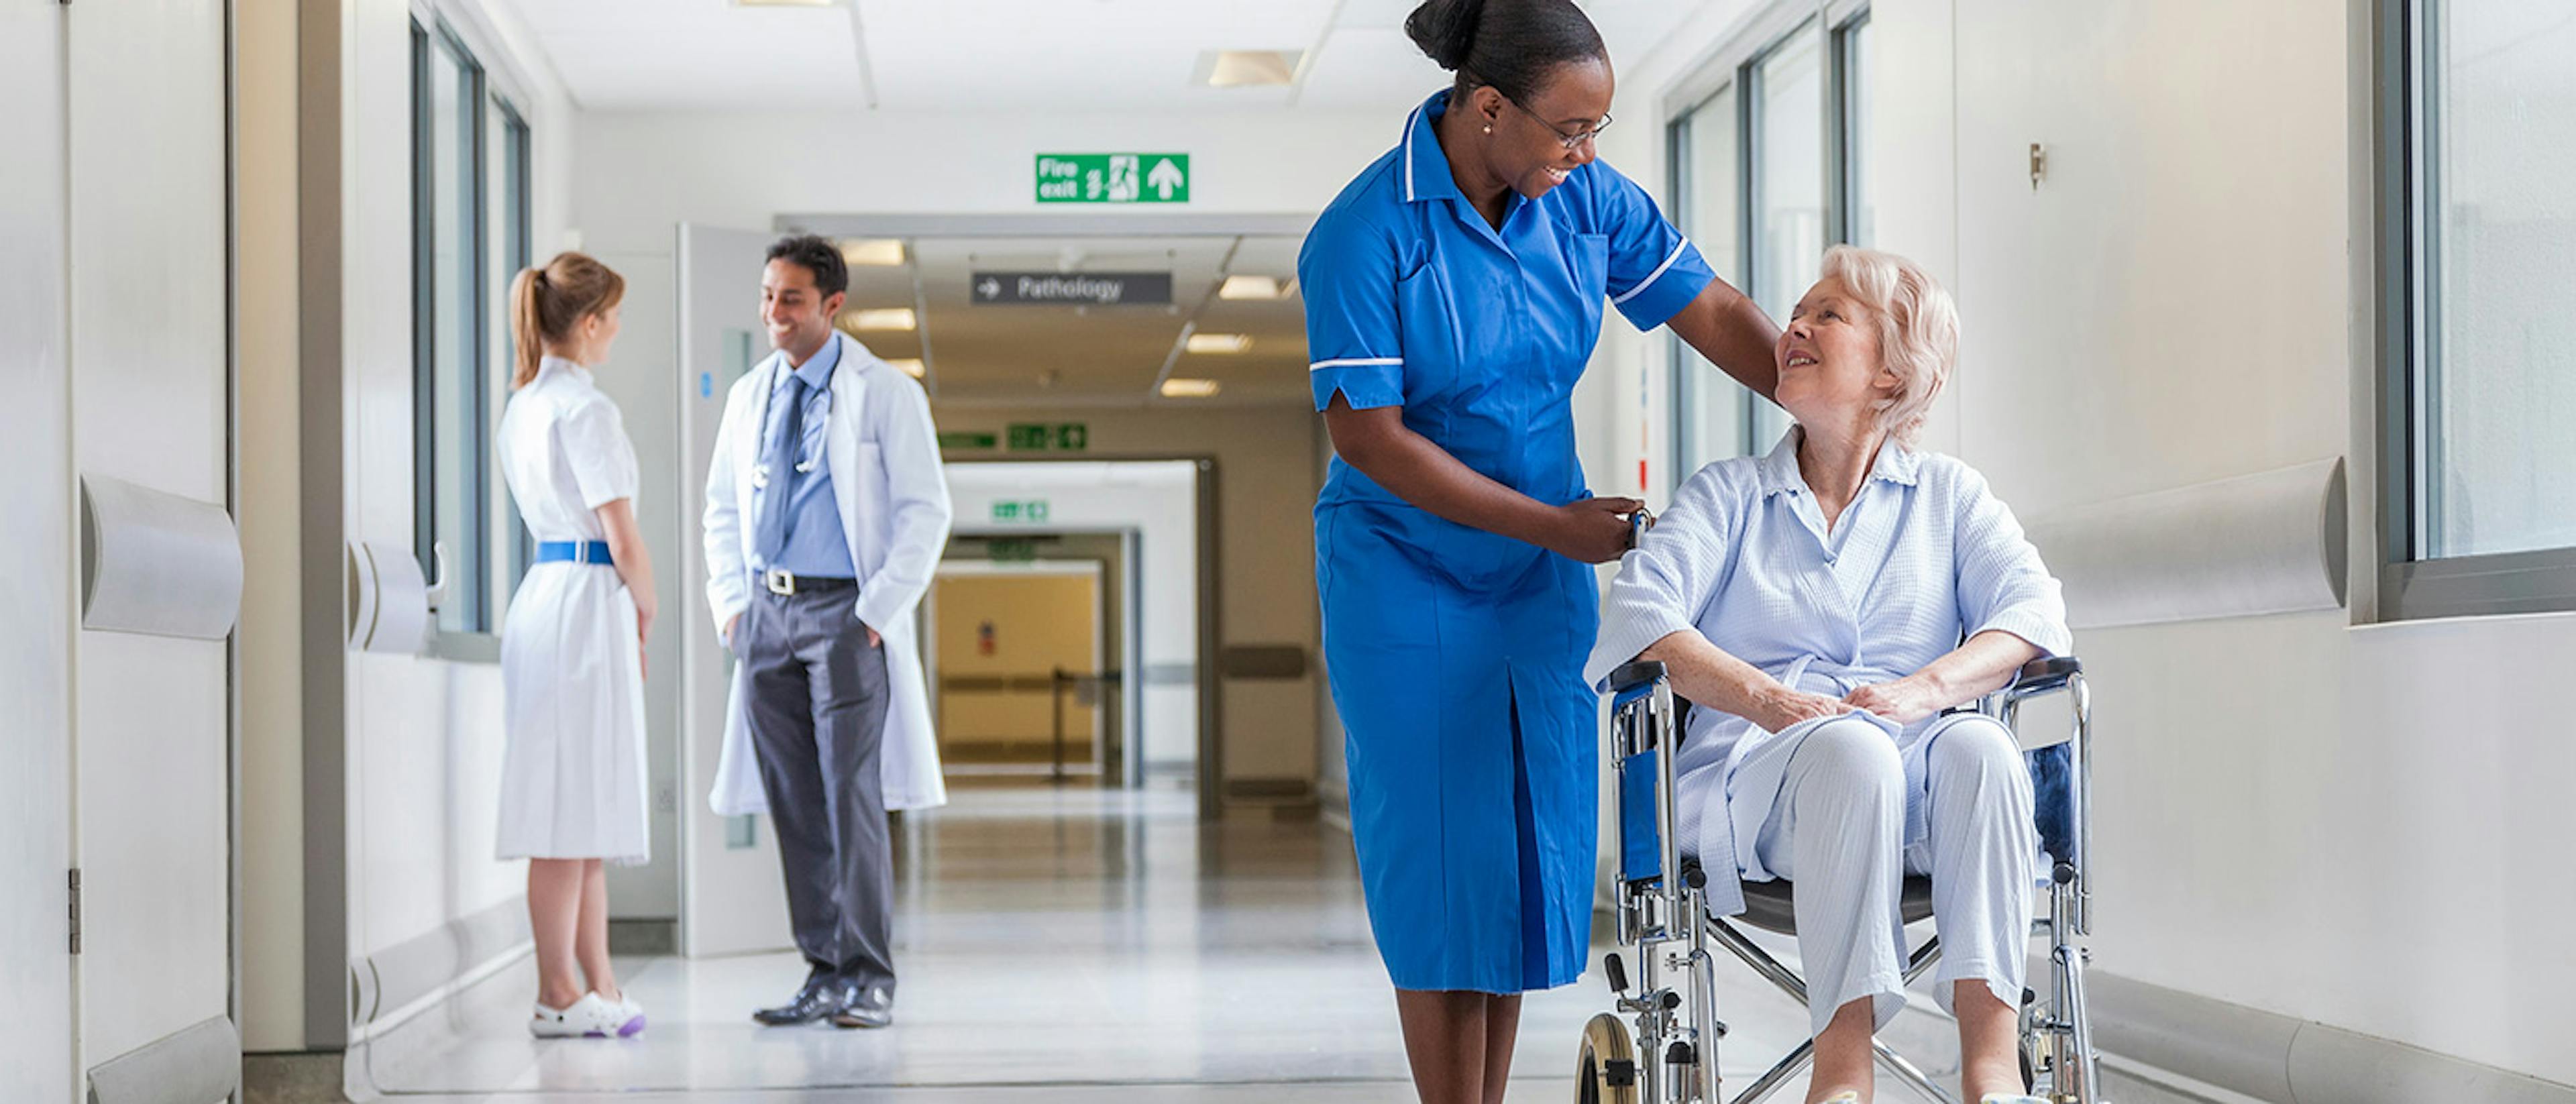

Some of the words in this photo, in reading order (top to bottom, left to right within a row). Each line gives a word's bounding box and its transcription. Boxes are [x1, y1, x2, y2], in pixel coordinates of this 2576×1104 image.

[1039, 158, 1079, 178] Fire
[1039, 179, 1078, 199] exit
[1018, 276, 1124, 302] Pathology
